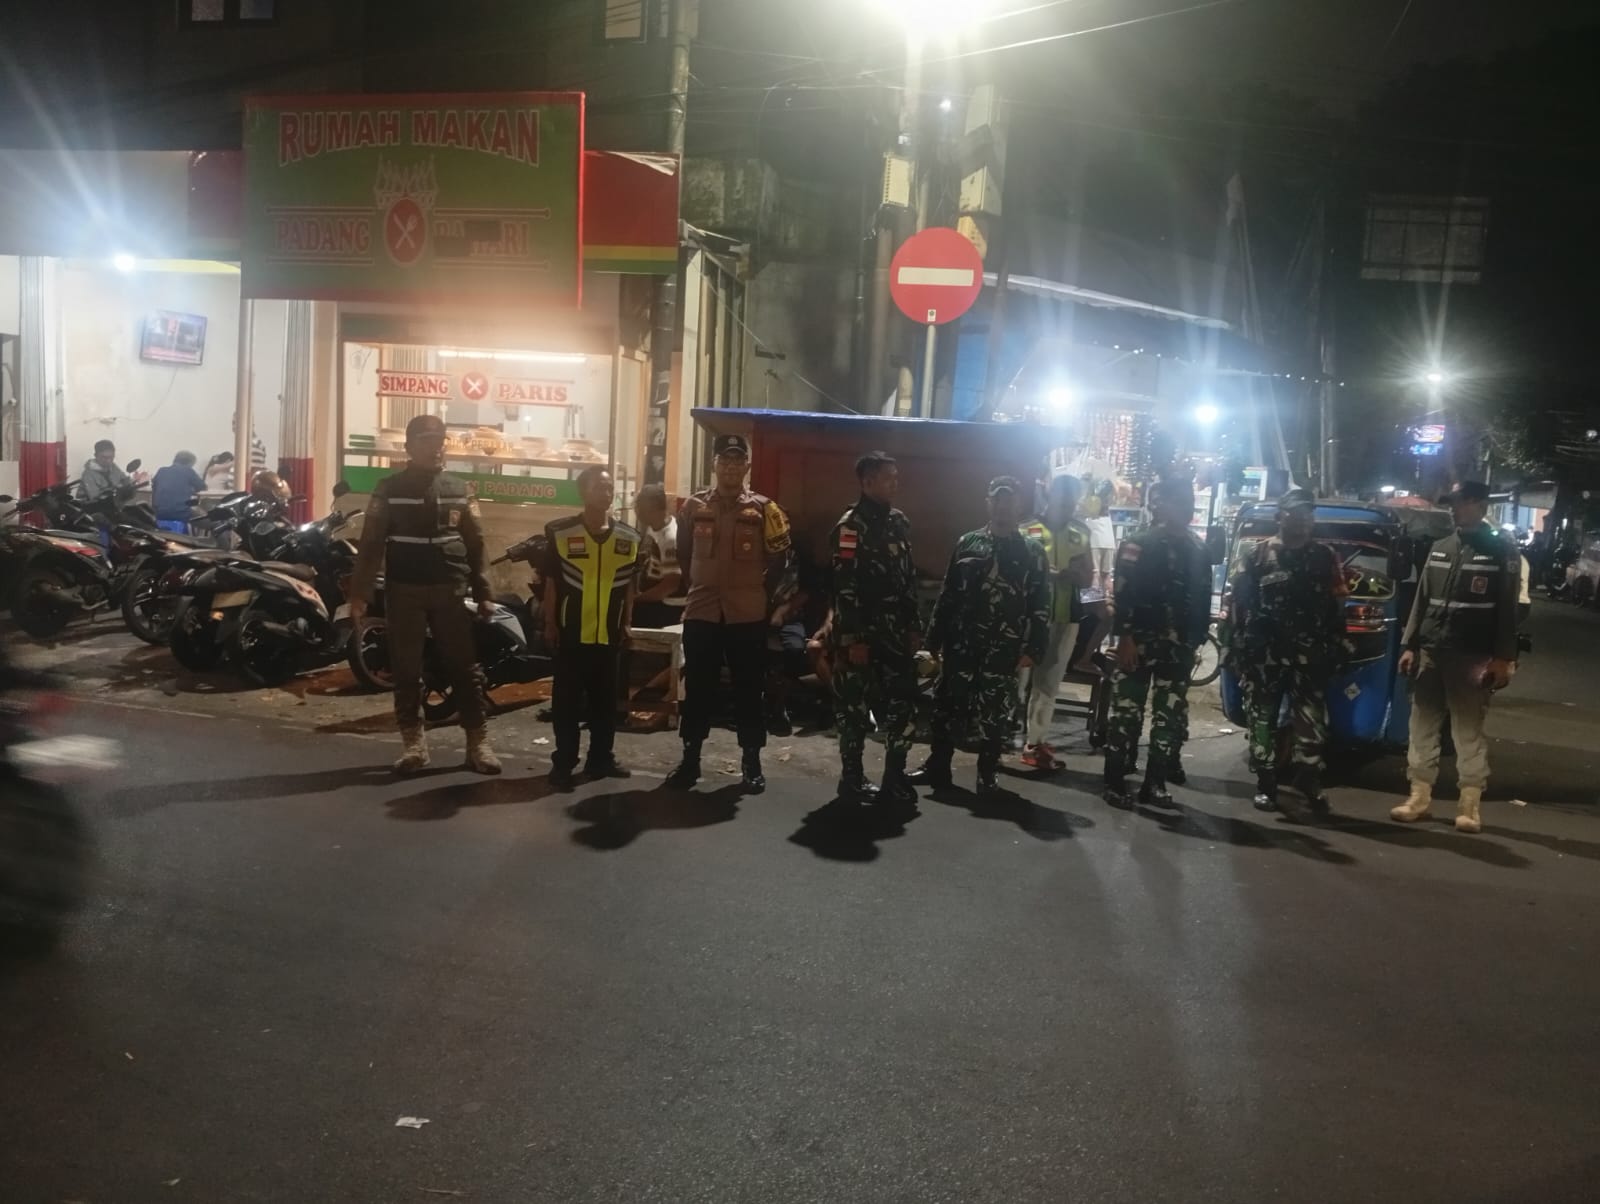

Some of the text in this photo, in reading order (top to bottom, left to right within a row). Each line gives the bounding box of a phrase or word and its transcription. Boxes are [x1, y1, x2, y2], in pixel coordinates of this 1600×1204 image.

[279, 110, 540, 168] RUMAH MAKAN
[272, 218, 372, 255] PADANG
[381, 376, 567, 402] SIMPANG PARIS
[484, 480, 557, 499] PADANG
